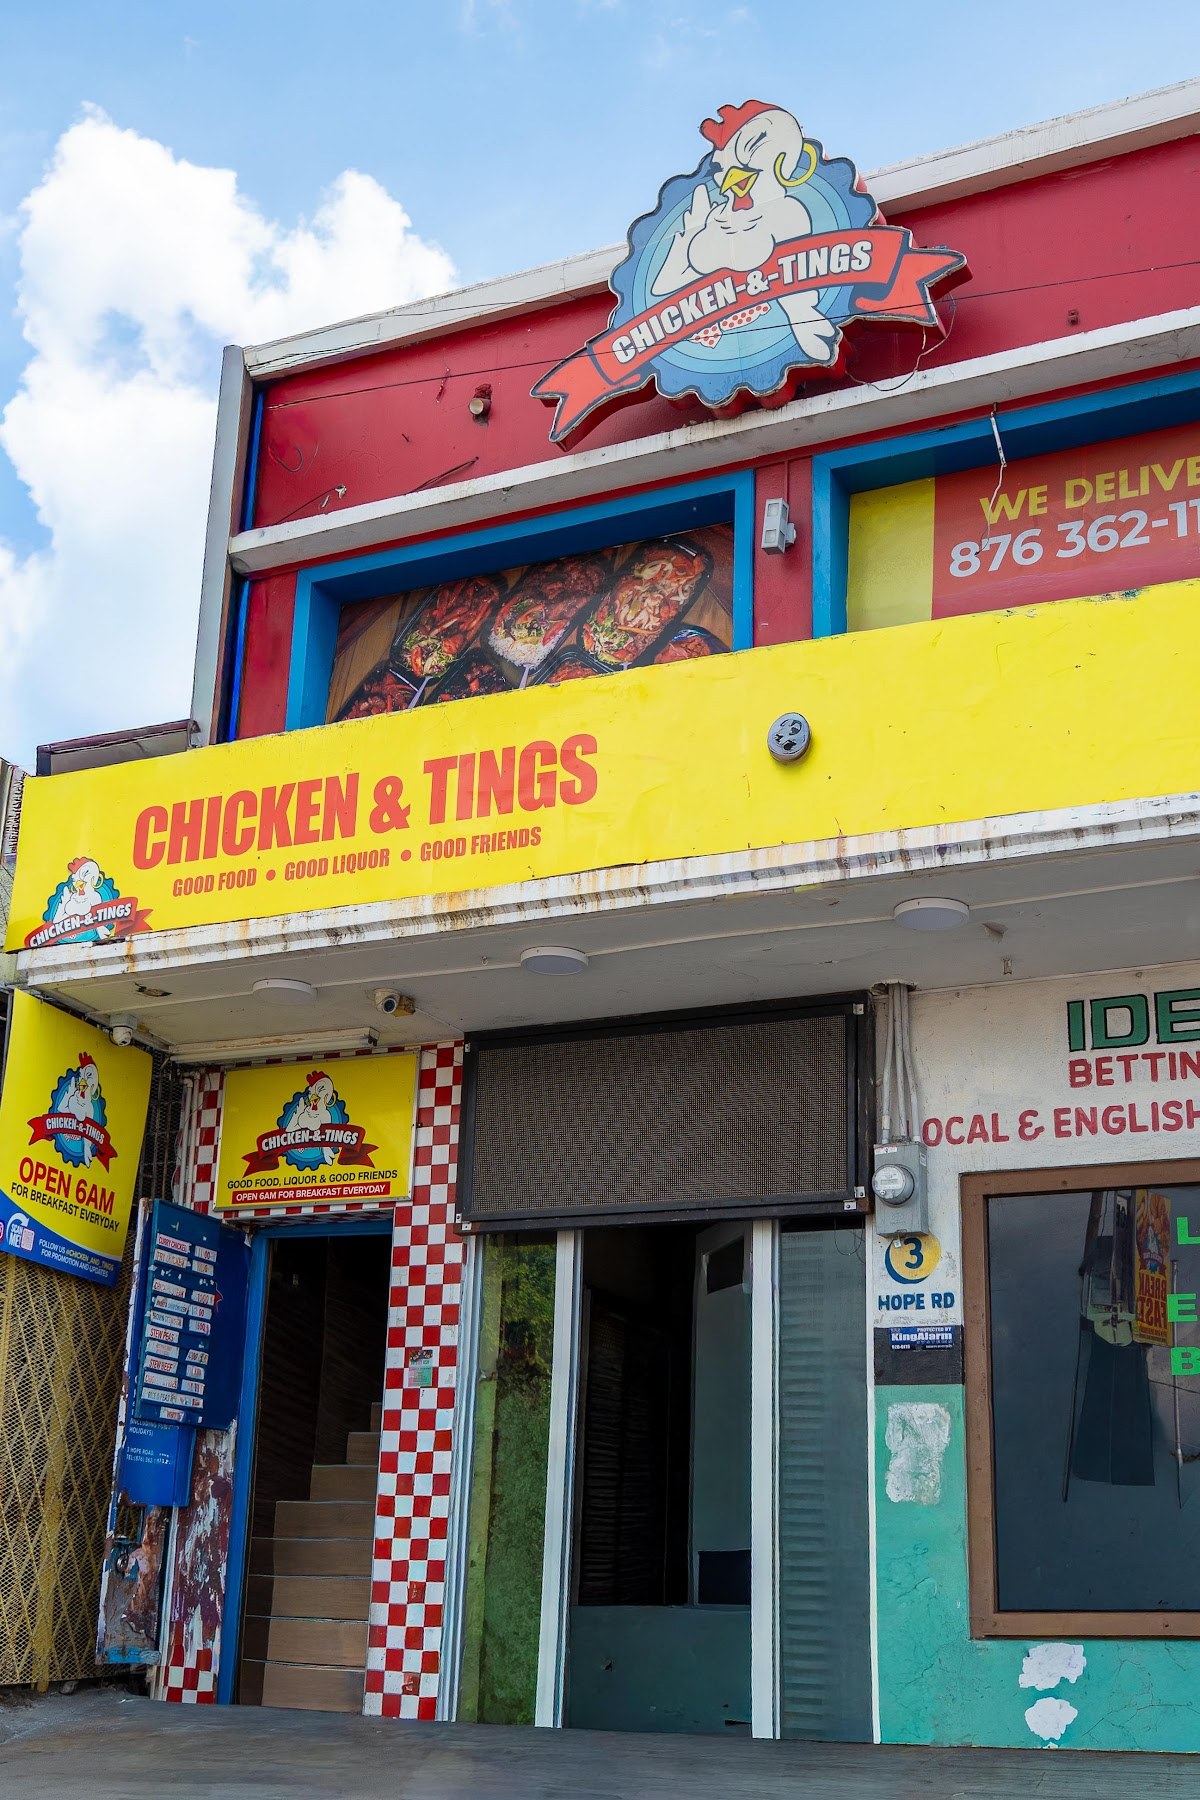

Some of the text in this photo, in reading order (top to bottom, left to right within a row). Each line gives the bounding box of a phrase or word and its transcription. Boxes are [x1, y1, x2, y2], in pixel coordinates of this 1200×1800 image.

[979, 485, 1048, 525] WE
[949, 528, 1044, 578] 876
[133, 733, 598, 870] CHICKEN & TINGS
[172, 825, 542, 897] GOOD FOOD GOOD LIQUOR GOOD FRIENDS
[1068, 1051, 1200, 1088] BETTIN
[906, 1112, 1010, 1147] OCAL
[1018, 1109, 1045, 1142] &
[19, 1156, 116, 1216] OPEN 6AM
[227, 1170, 398, 1189] GOOD FOOD, LIQUOR & GOOD FRIENDS
[236, 1184, 386, 1202] OPEN 6AM FOR BREAKFAST EVERYDAY
[11, 1182, 120, 1233] FOR BREAKFAST EVERYDAY
[11, 1223, 24, 1235] SCAN
[39, 1238, 60, 1251] FOLLOW
[59, 1245, 66, 1254] US
[41, 1248, 51, 1258] FOR
[52, 1251, 79, 1268] PROMOTION
[79, 1261, 90, 1271] AND
[904, 1237, 924, 1269] 3
[878, 1292, 955, 1311] HOPE RD
[1167, 1294, 1198, 1322] E
[891, 1332, 953, 1342] KingAlarm
